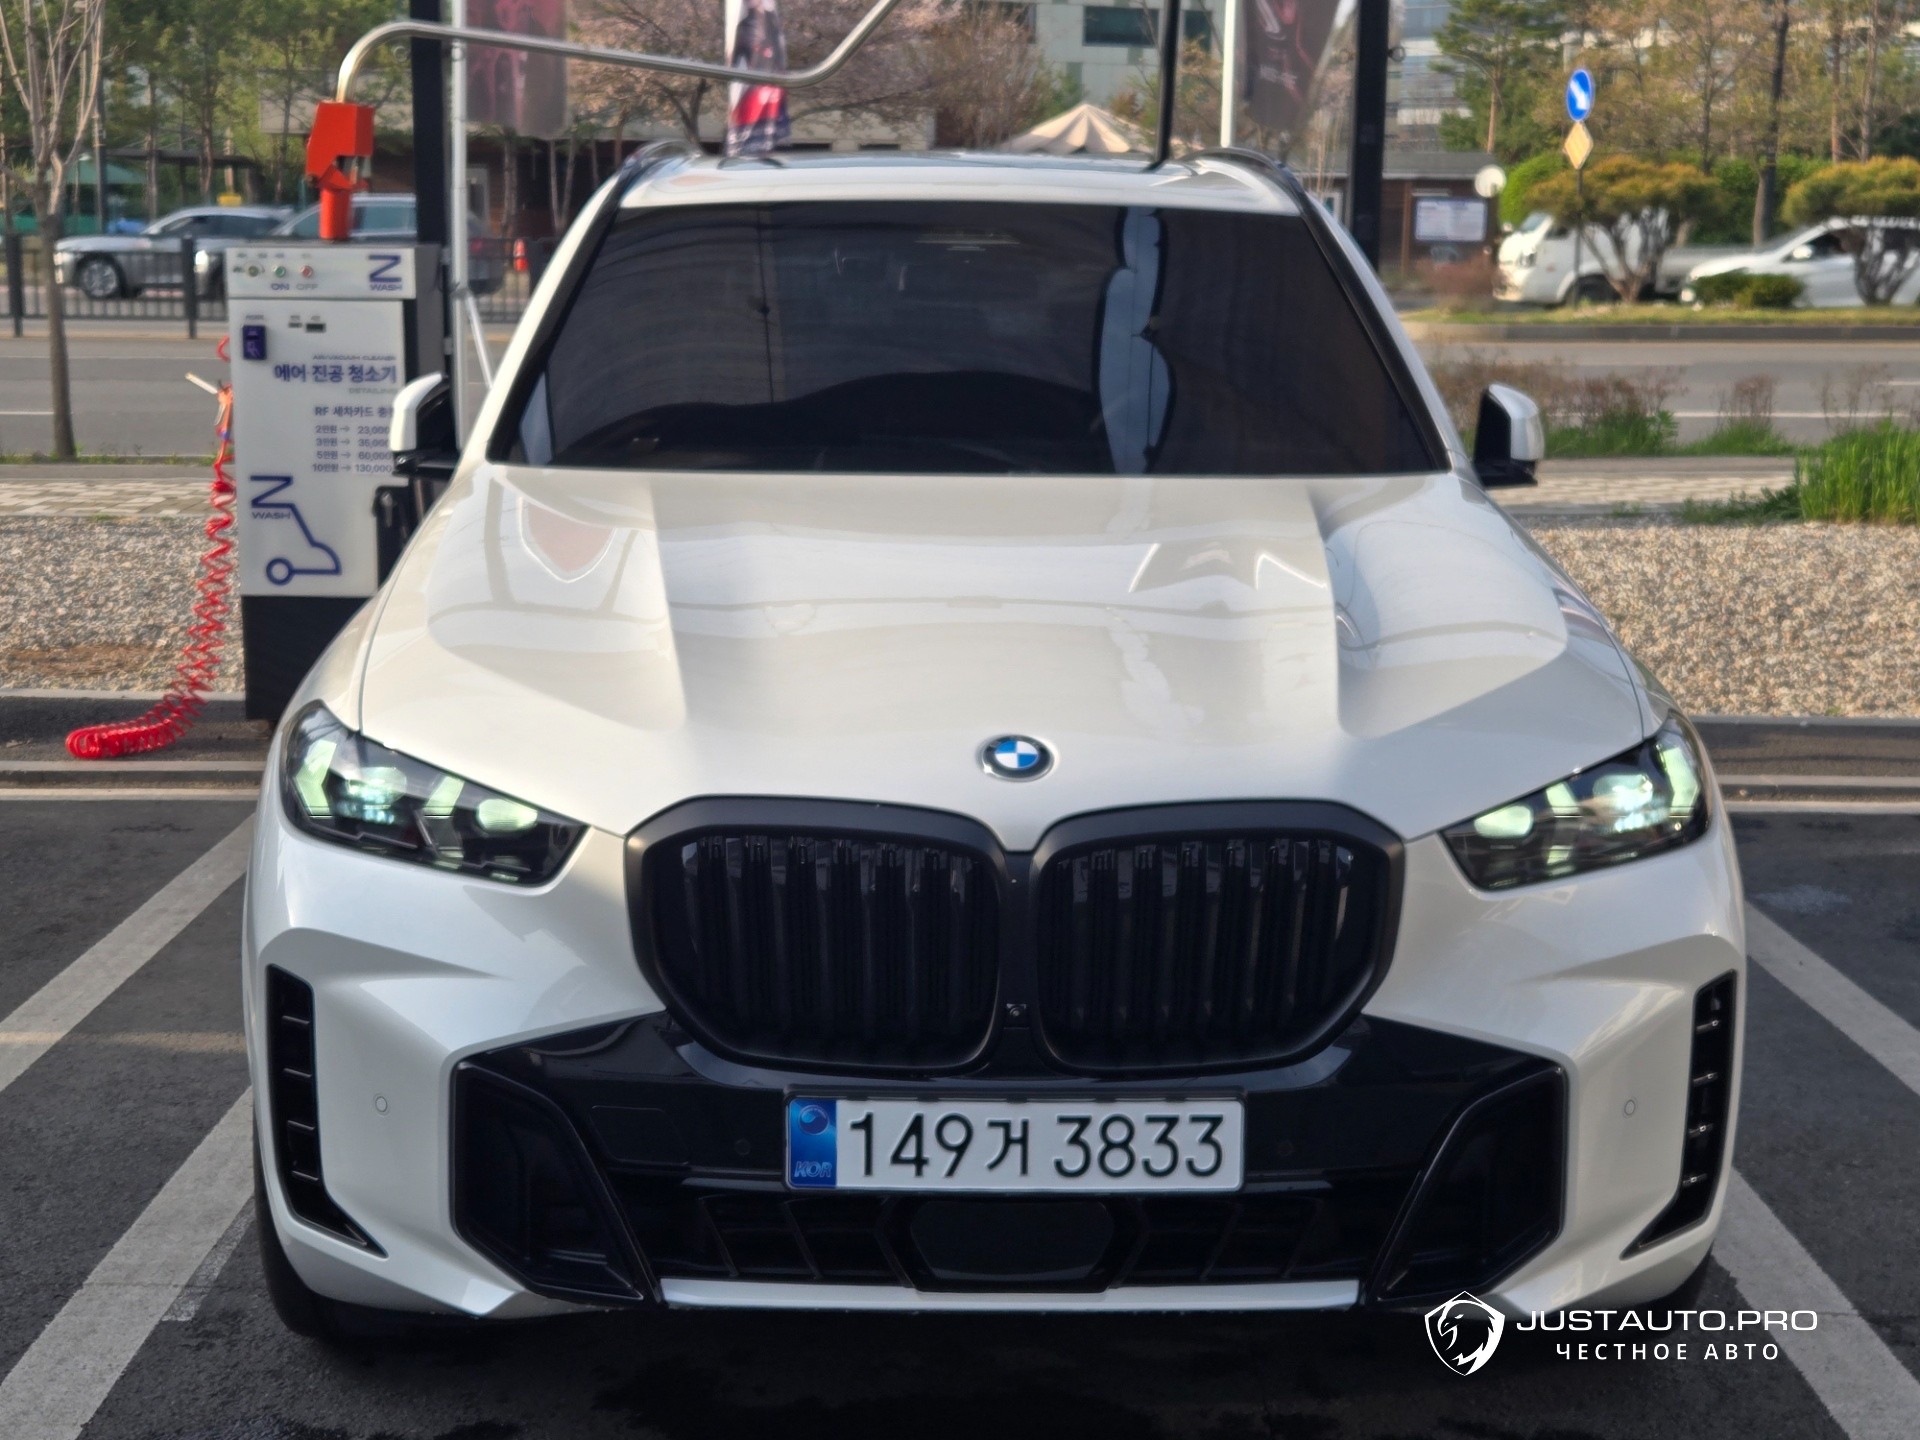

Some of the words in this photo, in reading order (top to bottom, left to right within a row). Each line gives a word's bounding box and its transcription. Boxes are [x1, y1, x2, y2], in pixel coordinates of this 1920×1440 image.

[271, 283, 290, 291] ON
[296, 283, 319, 291] OFF
[274, 364, 306, 382] 에어
[312, 364, 344, 383] 진공
[348, 364, 397, 384] 청소기
[314, 406, 329, 416] RF
[251, 511, 291, 520] WASH
[850, 1111, 1030, 1178] 149거
[1053, 1113, 1225, 1179] 3833
[793, 1160, 833, 1178] KOR
